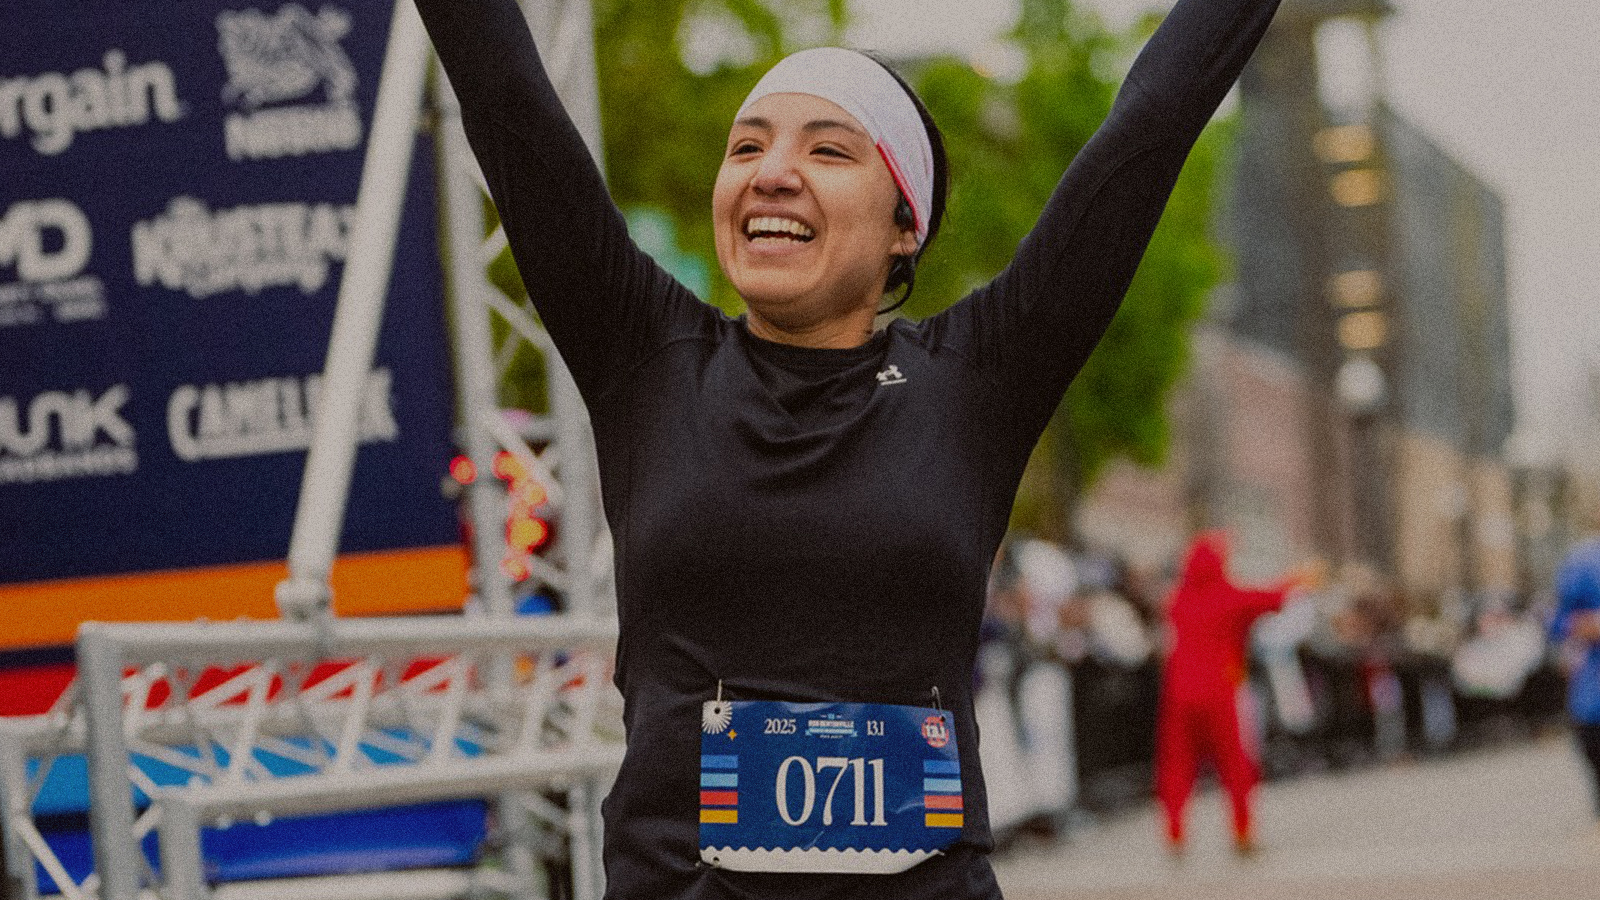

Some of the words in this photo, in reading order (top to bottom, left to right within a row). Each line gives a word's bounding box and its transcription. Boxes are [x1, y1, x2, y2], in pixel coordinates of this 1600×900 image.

[167, 369, 398, 461] CAMELK
[764, 718, 797, 735] 2025
[776, 755, 888, 826] 0711
